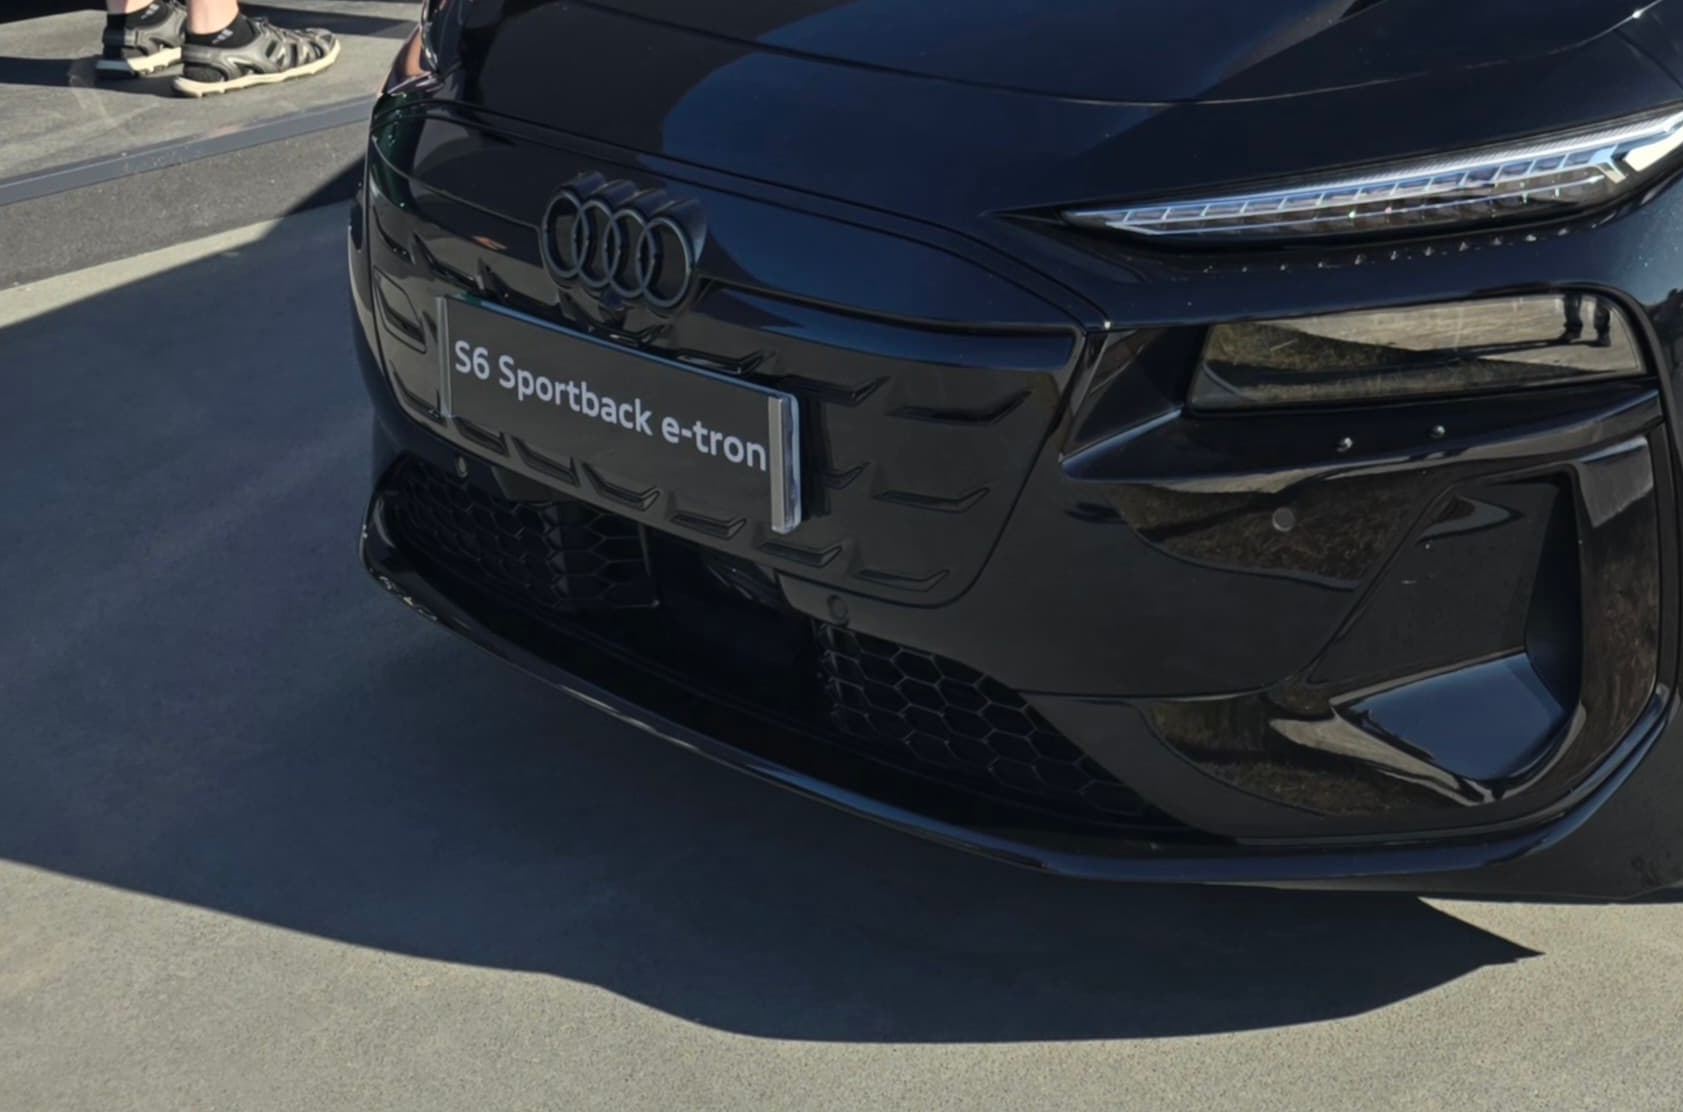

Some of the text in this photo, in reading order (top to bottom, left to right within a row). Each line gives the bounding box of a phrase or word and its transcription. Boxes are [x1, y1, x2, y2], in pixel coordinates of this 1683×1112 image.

[455, 340, 767, 472] S6 Sportback e-tron
